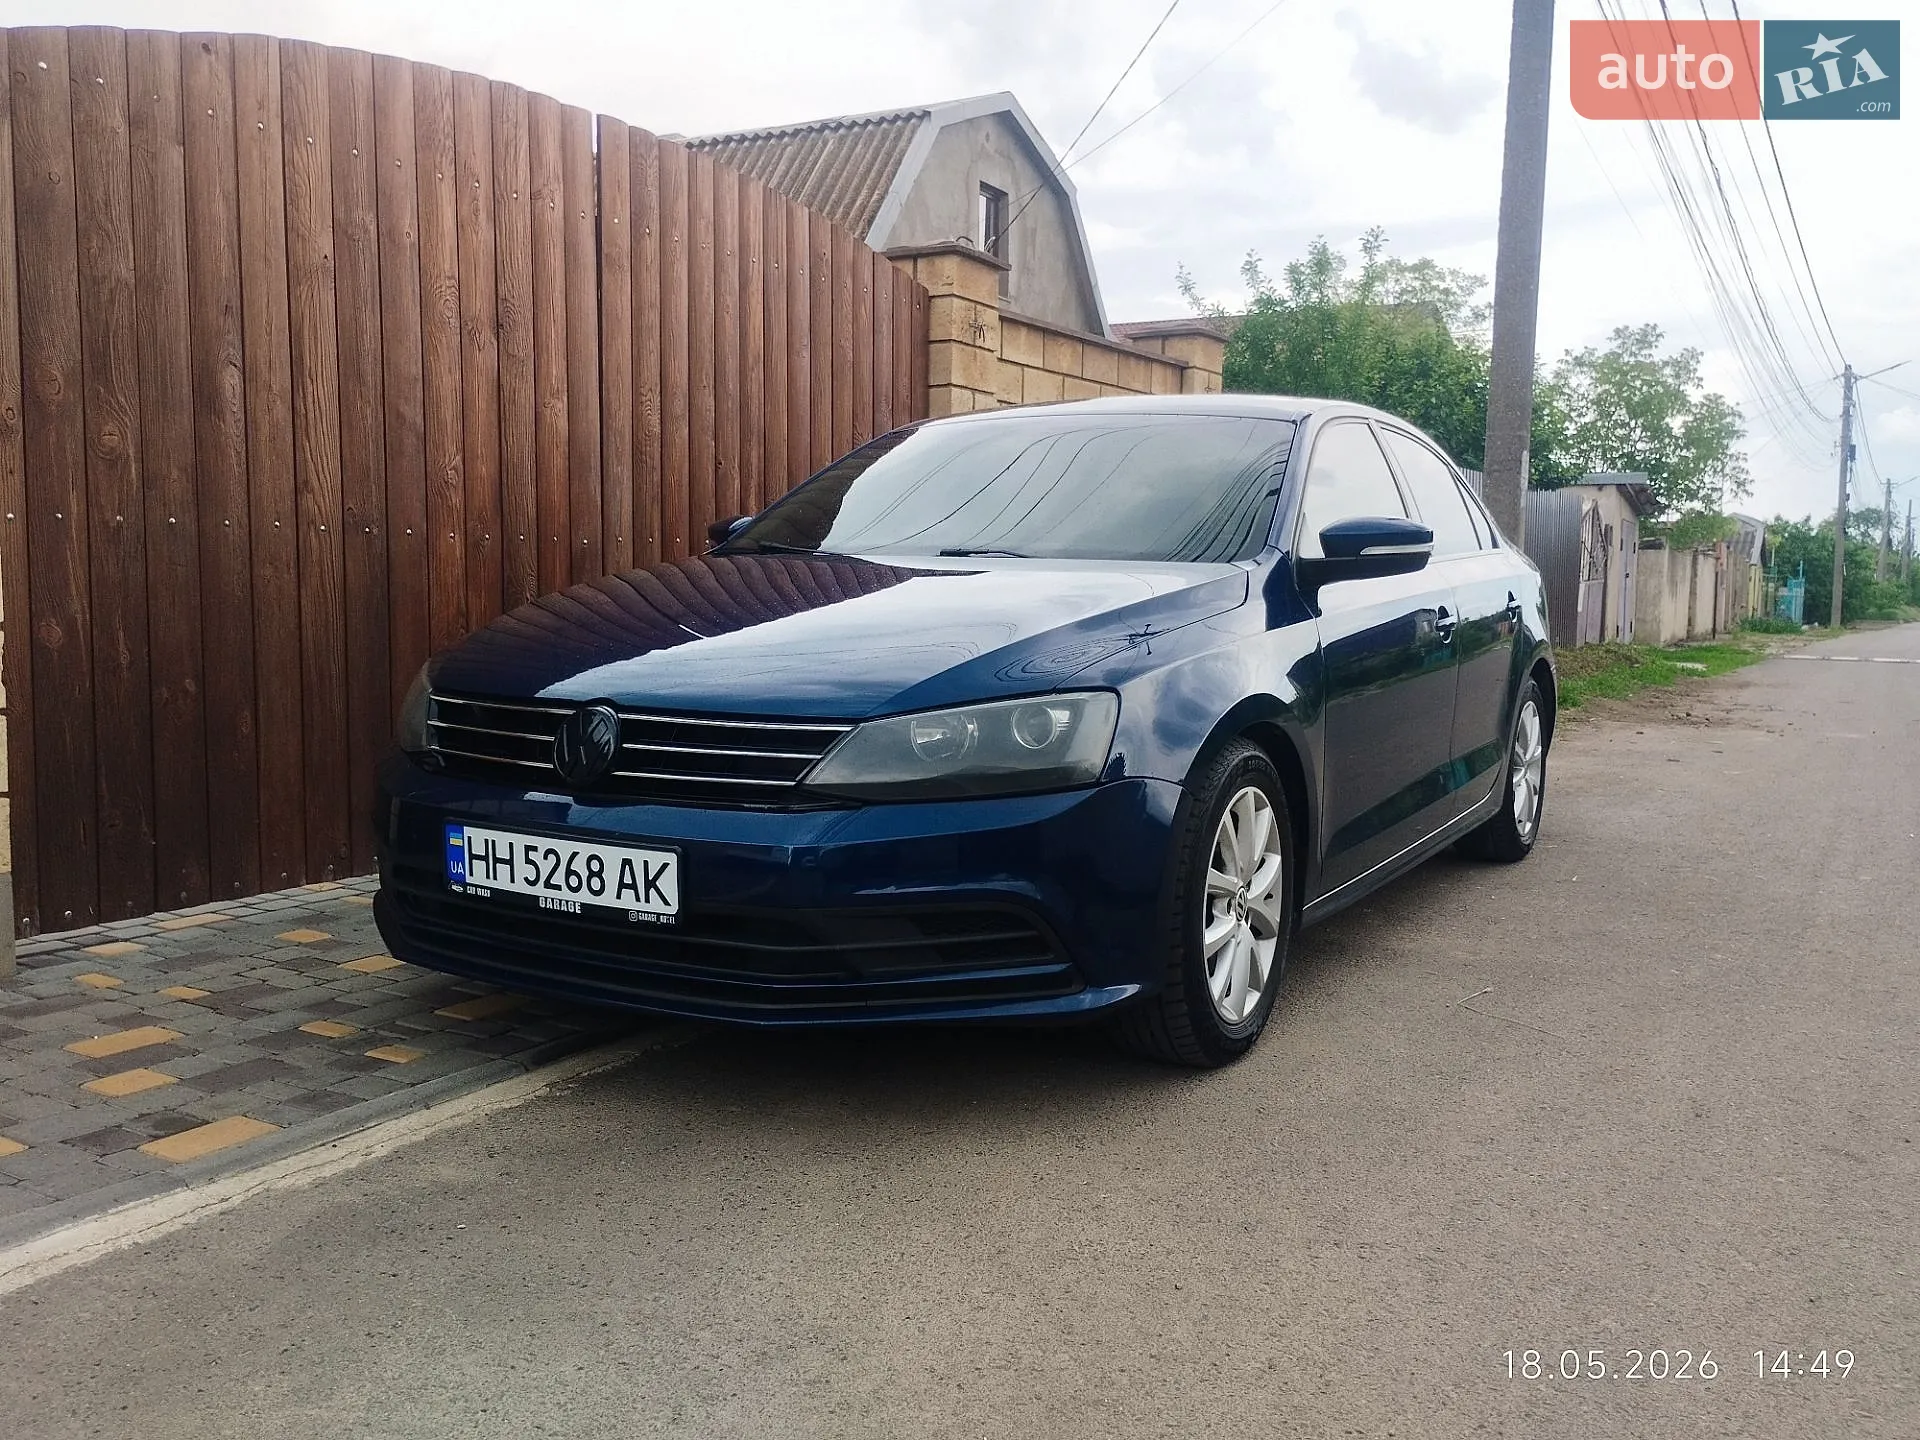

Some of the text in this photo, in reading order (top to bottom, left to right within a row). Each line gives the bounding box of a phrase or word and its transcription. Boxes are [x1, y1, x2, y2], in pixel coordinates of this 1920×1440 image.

[450, 860, 465, 876] UA
[467, 835, 672, 907] HH 5268 AK
[539, 896, 582, 914] GARAGE
